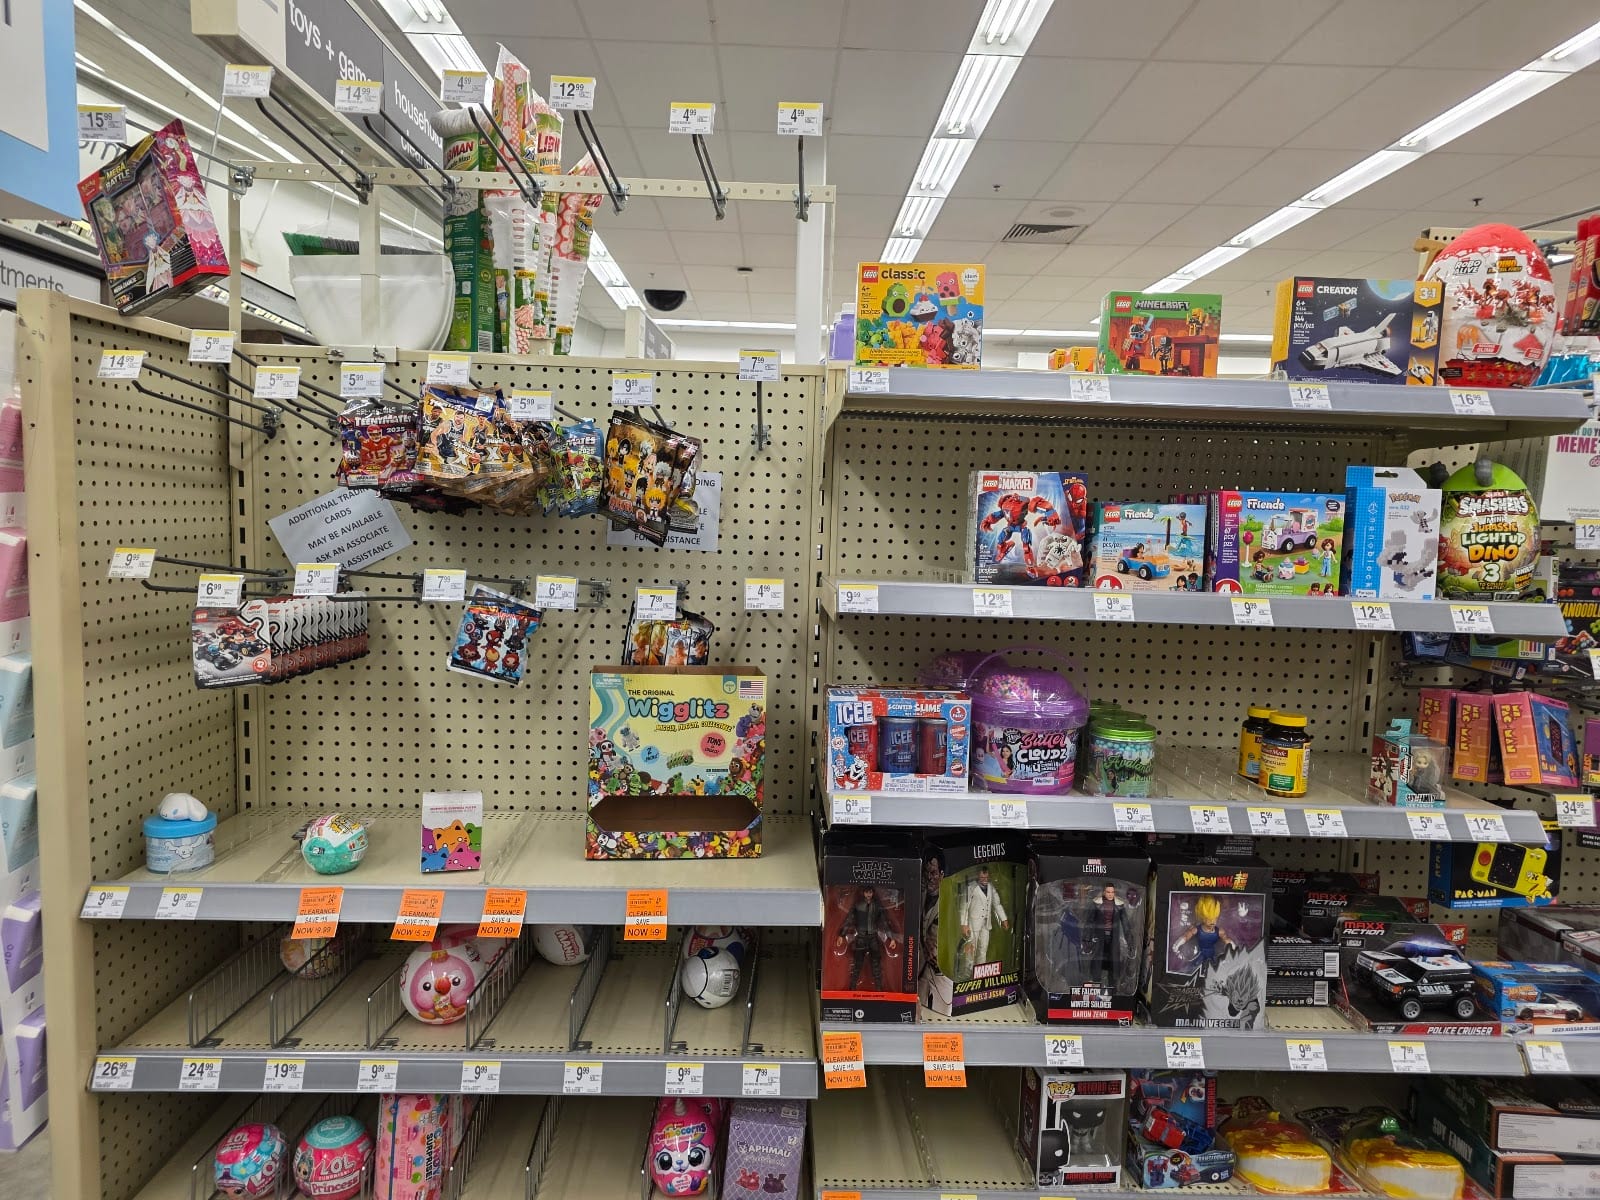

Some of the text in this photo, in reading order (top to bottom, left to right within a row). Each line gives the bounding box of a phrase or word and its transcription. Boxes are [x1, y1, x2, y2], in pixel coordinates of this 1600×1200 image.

[289, 0, 321, 50] toys
[106, 163, 126, 179] MEGA
[105, 168, 131, 189] BATTLE
[1455, 266, 1479, 274] ALIVE
[1456, 260, 1481, 268] ROBO
[881, 268, 926, 280] classic
[1317, 286, 1359, 295] CREATOR
[1116, 300, 1190, 311] LEGO MINECRAFT
[695, 479, 716, 488] DING
[984, 477, 1033, 491] LEGO MARVEL
[1246, 497, 1285, 511] Friends
[1459, 497, 1529, 515] SMASHERS
[288, 496, 338, 527] ADDITIONAL
[324, 507, 352, 524] CARDS
[1123, 509, 1155, 521] Friends
[307, 510, 384, 550] MAY BE AVAILABLE
[1471, 522, 1518, 532] JURASSIC
[315, 525, 389, 564] ASK AN ASSOCIATE
[346, 540, 393, 570] ASSISTANCE
[1365, 517, 1377, 589] nanoblock
[1469, 545, 1519, 562] DINO
[1483, 563, 1500, 582] 3
[628, 697, 729, 723] Wigglitz
[836, 702, 873, 726] ICEE
[914, 703, 941, 714] SLIME
[1459, 704, 1472, 752] PAC-MAN
[1501, 703, 1518, 753] PAC-MAN
[707, 736, 722, 746] TONS
[890, 730, 913, 746] ICEE
[1021, 731, 1067, 749] Butter
[1016, 749, 1068, 764] CLOUDZ
[973, 842, 1005, 858] LEGENDS
[854, 860, 892, 871] STAR
[1082, 865, 1107, 874] LEGENDS
[853, 870, 892, 880] WARS
[1183, 871, 1217, 887] DRAGON
[1454, 889, 1497, 898] PAC-MAN
[1307, 899, 1348, 907] ACTION
[480, 926, 501, 934] NOW
[1343, 928, 1385, 936] ACTION
[1344, 921, 1385, 930] MAXX
[974, 962, 1002, 979] MARVEL
[954, 973, 1018, 994] SUPER VILLAINS
[1417, 984, 1453, 995] POLICE
[1071, 988, 1101, 996] THE FALCON
[1071, 1001, 1112, 1009] WINTER SOLDIER
[1072, 1011, 1108, 1019] BARON ZEMO
[1175, 1018, 1240, 1029] MAJIN VEGETA
[1427, 1026, 1494, 1036] POLICE CRUISER
[1047, 1081, 1074, 1095] POP!
[653, 1122, 707, 1144] Rainbocorns
[1432, 1116, 1446, 1140] SPY
[1448, 1129, 1474, 1163] FAMILY
[425, 1132, 434, 1182] SURPRISE!
[433, 1128, 443, 1176] CANDY
[748, 1145, 792, 1158] APHMAU
[311, 1175, 360, 1195] Princess
